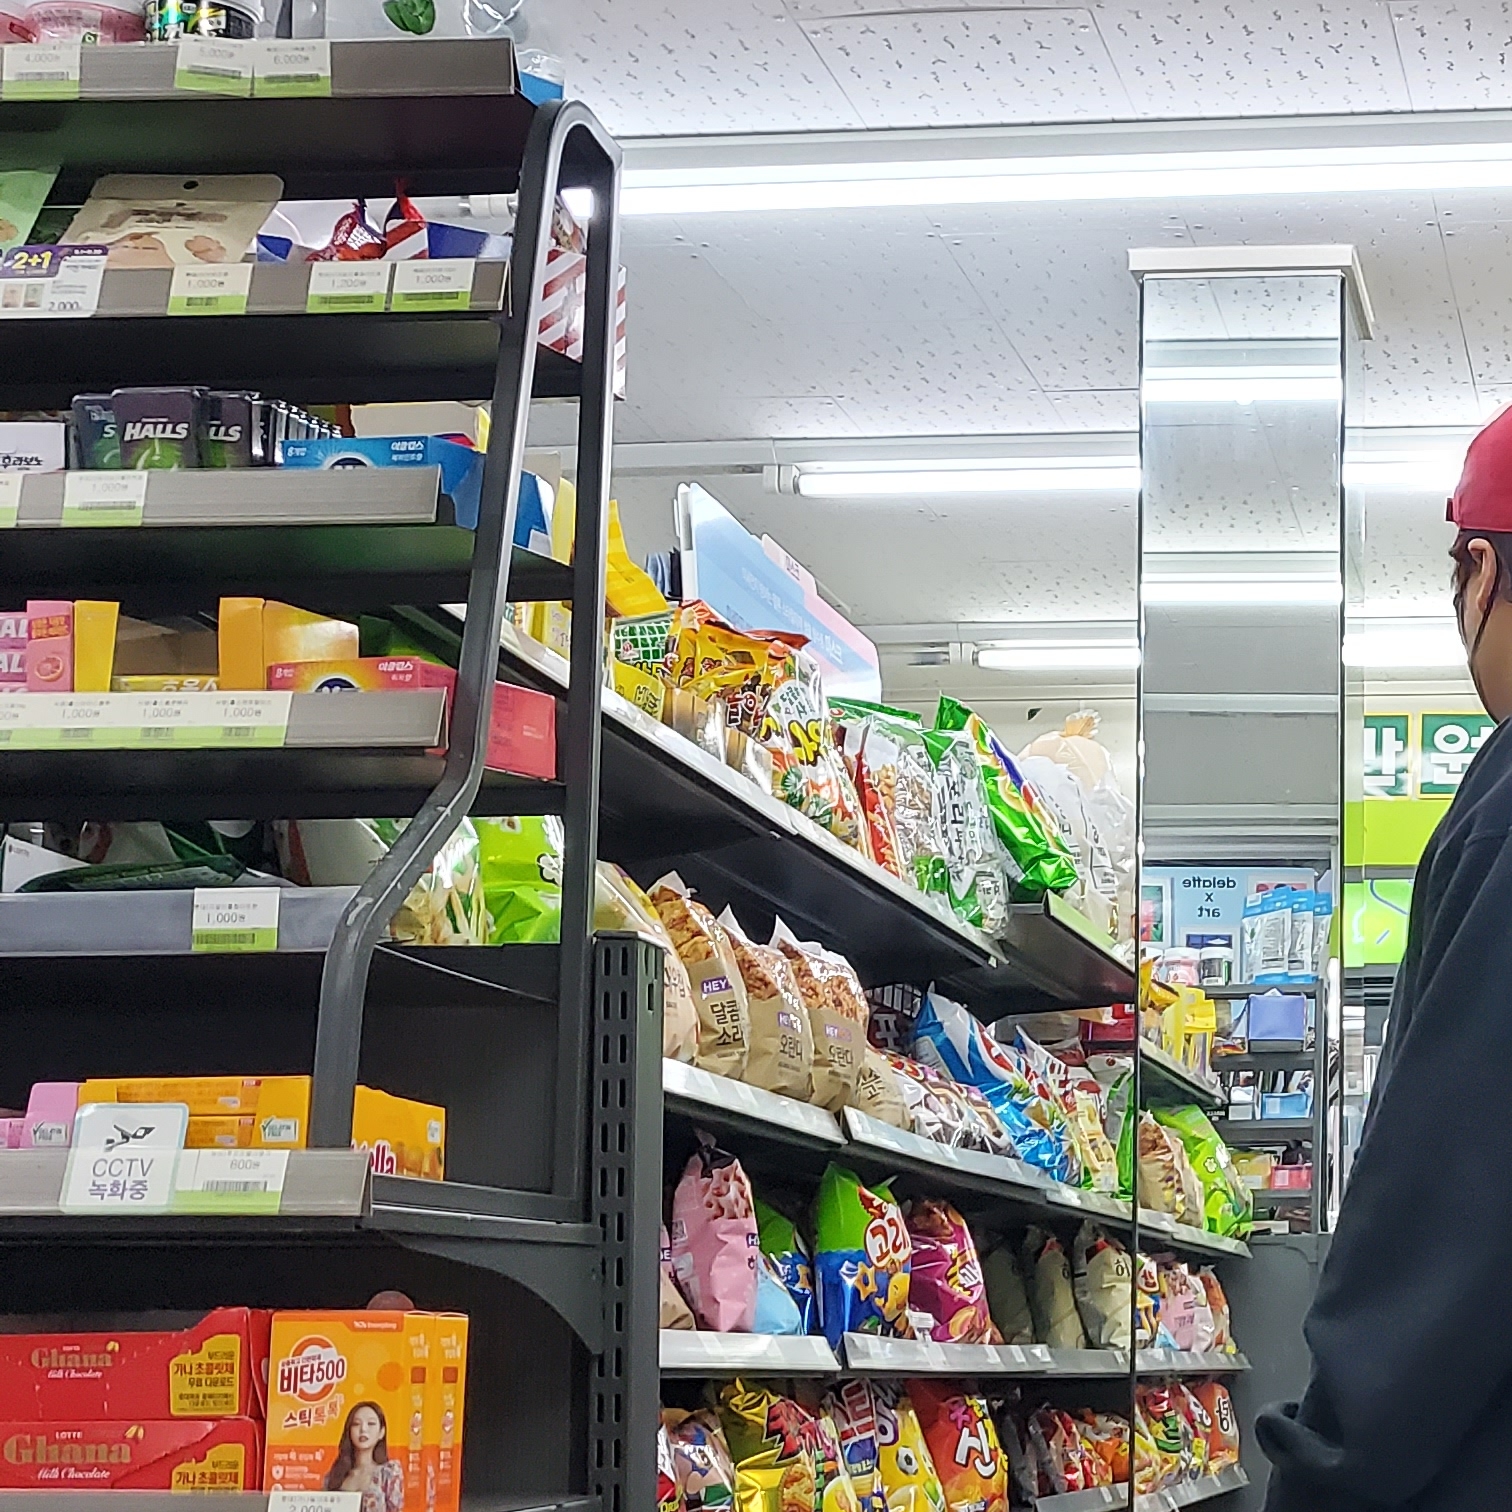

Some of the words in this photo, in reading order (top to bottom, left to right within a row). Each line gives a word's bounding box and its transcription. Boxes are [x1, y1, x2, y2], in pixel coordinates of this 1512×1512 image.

[13, 251, 52, 269] 2+1
[123, 422, 189, 441] HALLS
[710, 1000, 741, 1026] 달콤
[92, 1158, 153, 1177] CCTV
[89, 1179, 148, 1200] 녹화중
[31, 1348, 112, 1369] Ghana
[279, 1358, 346, 1394] 비타500
[55, 1431, 82, 1440] LOTTE
[3, 1434, 132, 1465] Ghana
